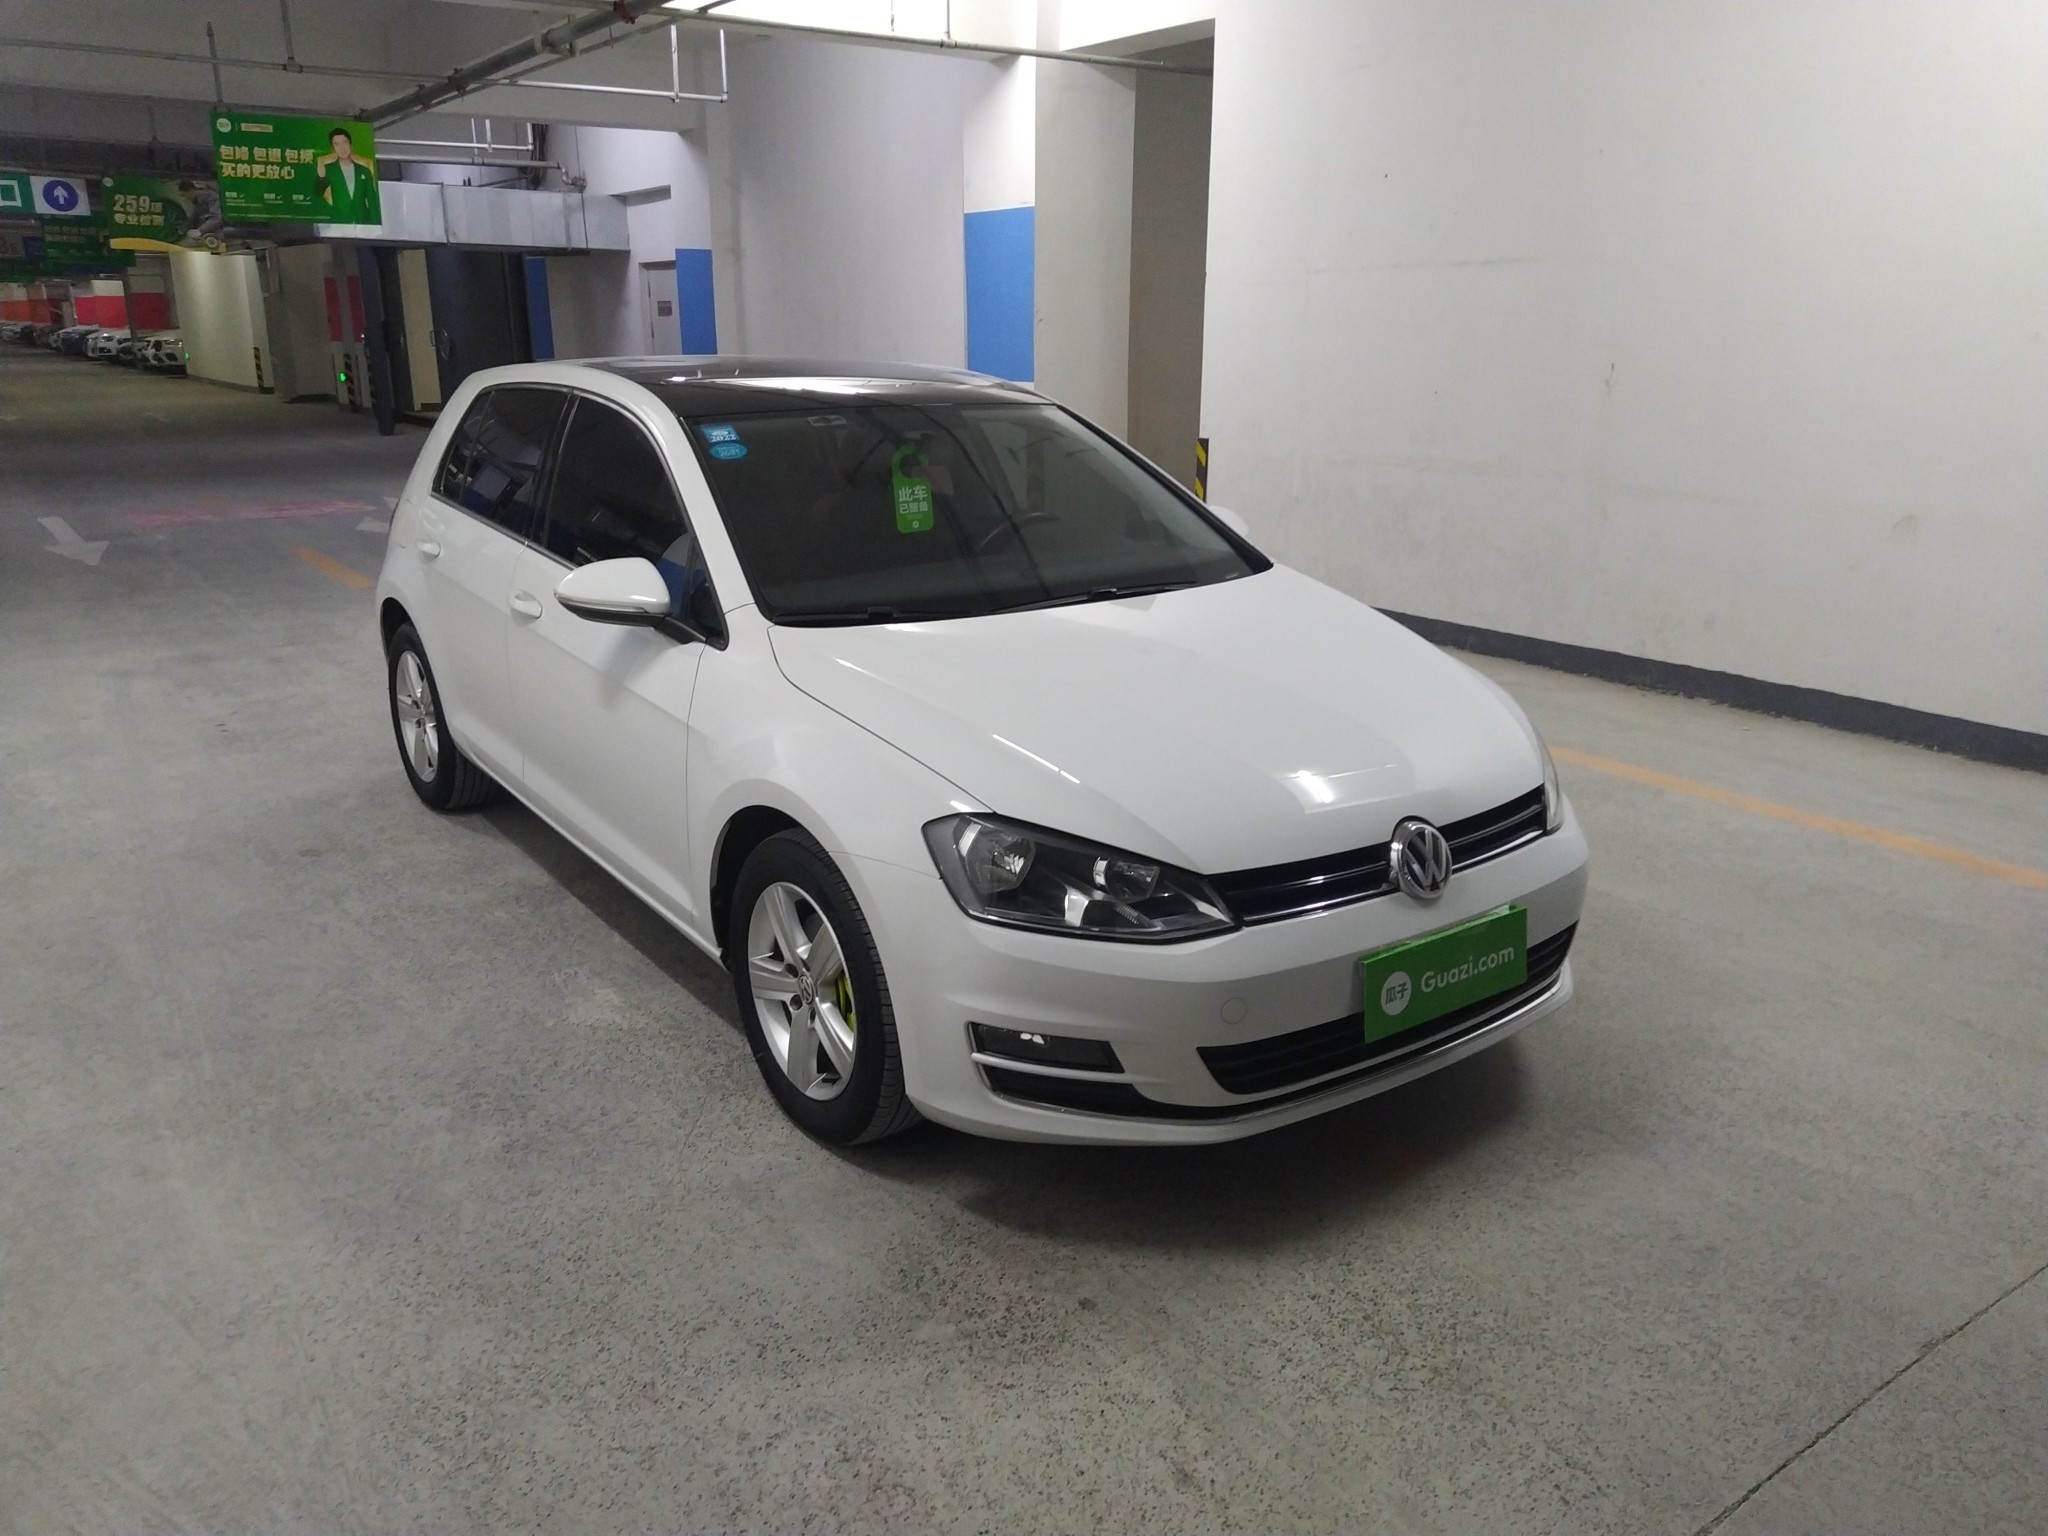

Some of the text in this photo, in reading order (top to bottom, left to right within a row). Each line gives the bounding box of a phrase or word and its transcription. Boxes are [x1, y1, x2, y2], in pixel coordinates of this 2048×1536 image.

[899, 485, 928, 502] 此车
[1420, 946, 1515, 993] Guazi.com
[1384, 983, 1409, 1005] 瓜子
